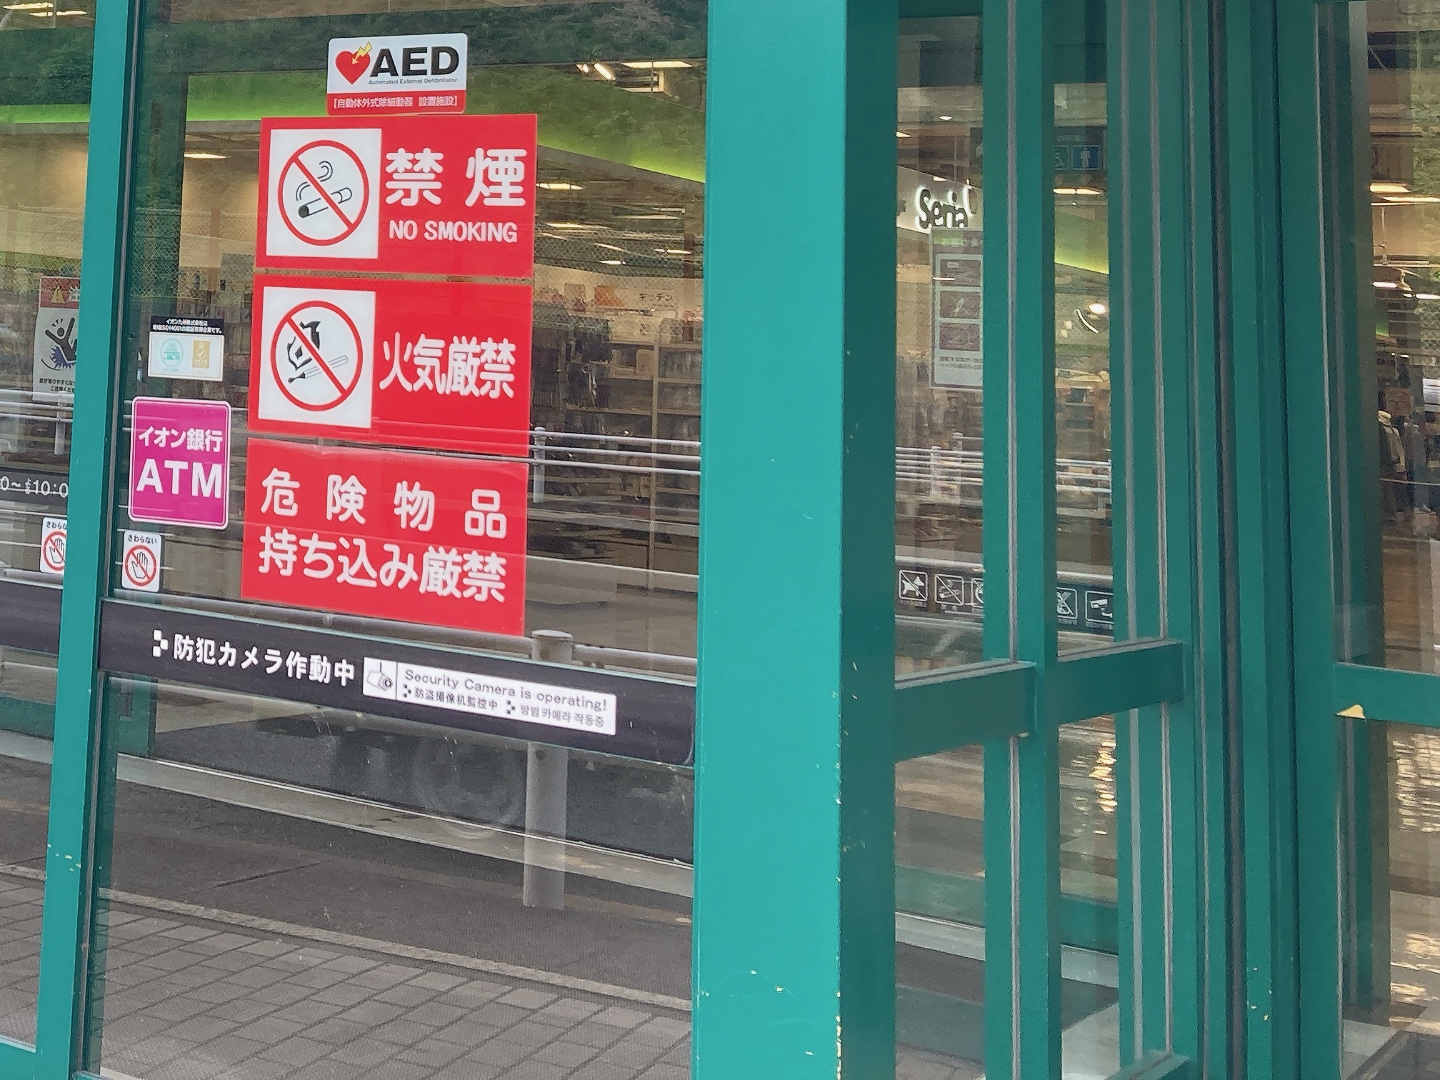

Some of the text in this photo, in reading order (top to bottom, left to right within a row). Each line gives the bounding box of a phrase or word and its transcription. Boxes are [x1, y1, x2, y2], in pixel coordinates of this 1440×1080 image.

[369, 45, 460, 78] AED
[385, 147, 528, 207] 禁煙
[388, 219, 518, 243] NO SMOKING
[379, 331, 517, 399] 火気厳禁
[138, 425, 224, 453] イオン銀行
[136, 457, 223, 499] ATM
[260, 467, 508, 540] 危険物品
[127, 533, 158, 545] さわらない
[258, 525, 508, 604] 持ち込み厳禁
[172, 633, 356, 688] 防犯カメラ作動中
[404, 669, 608, 713] Security Camera is operating!
